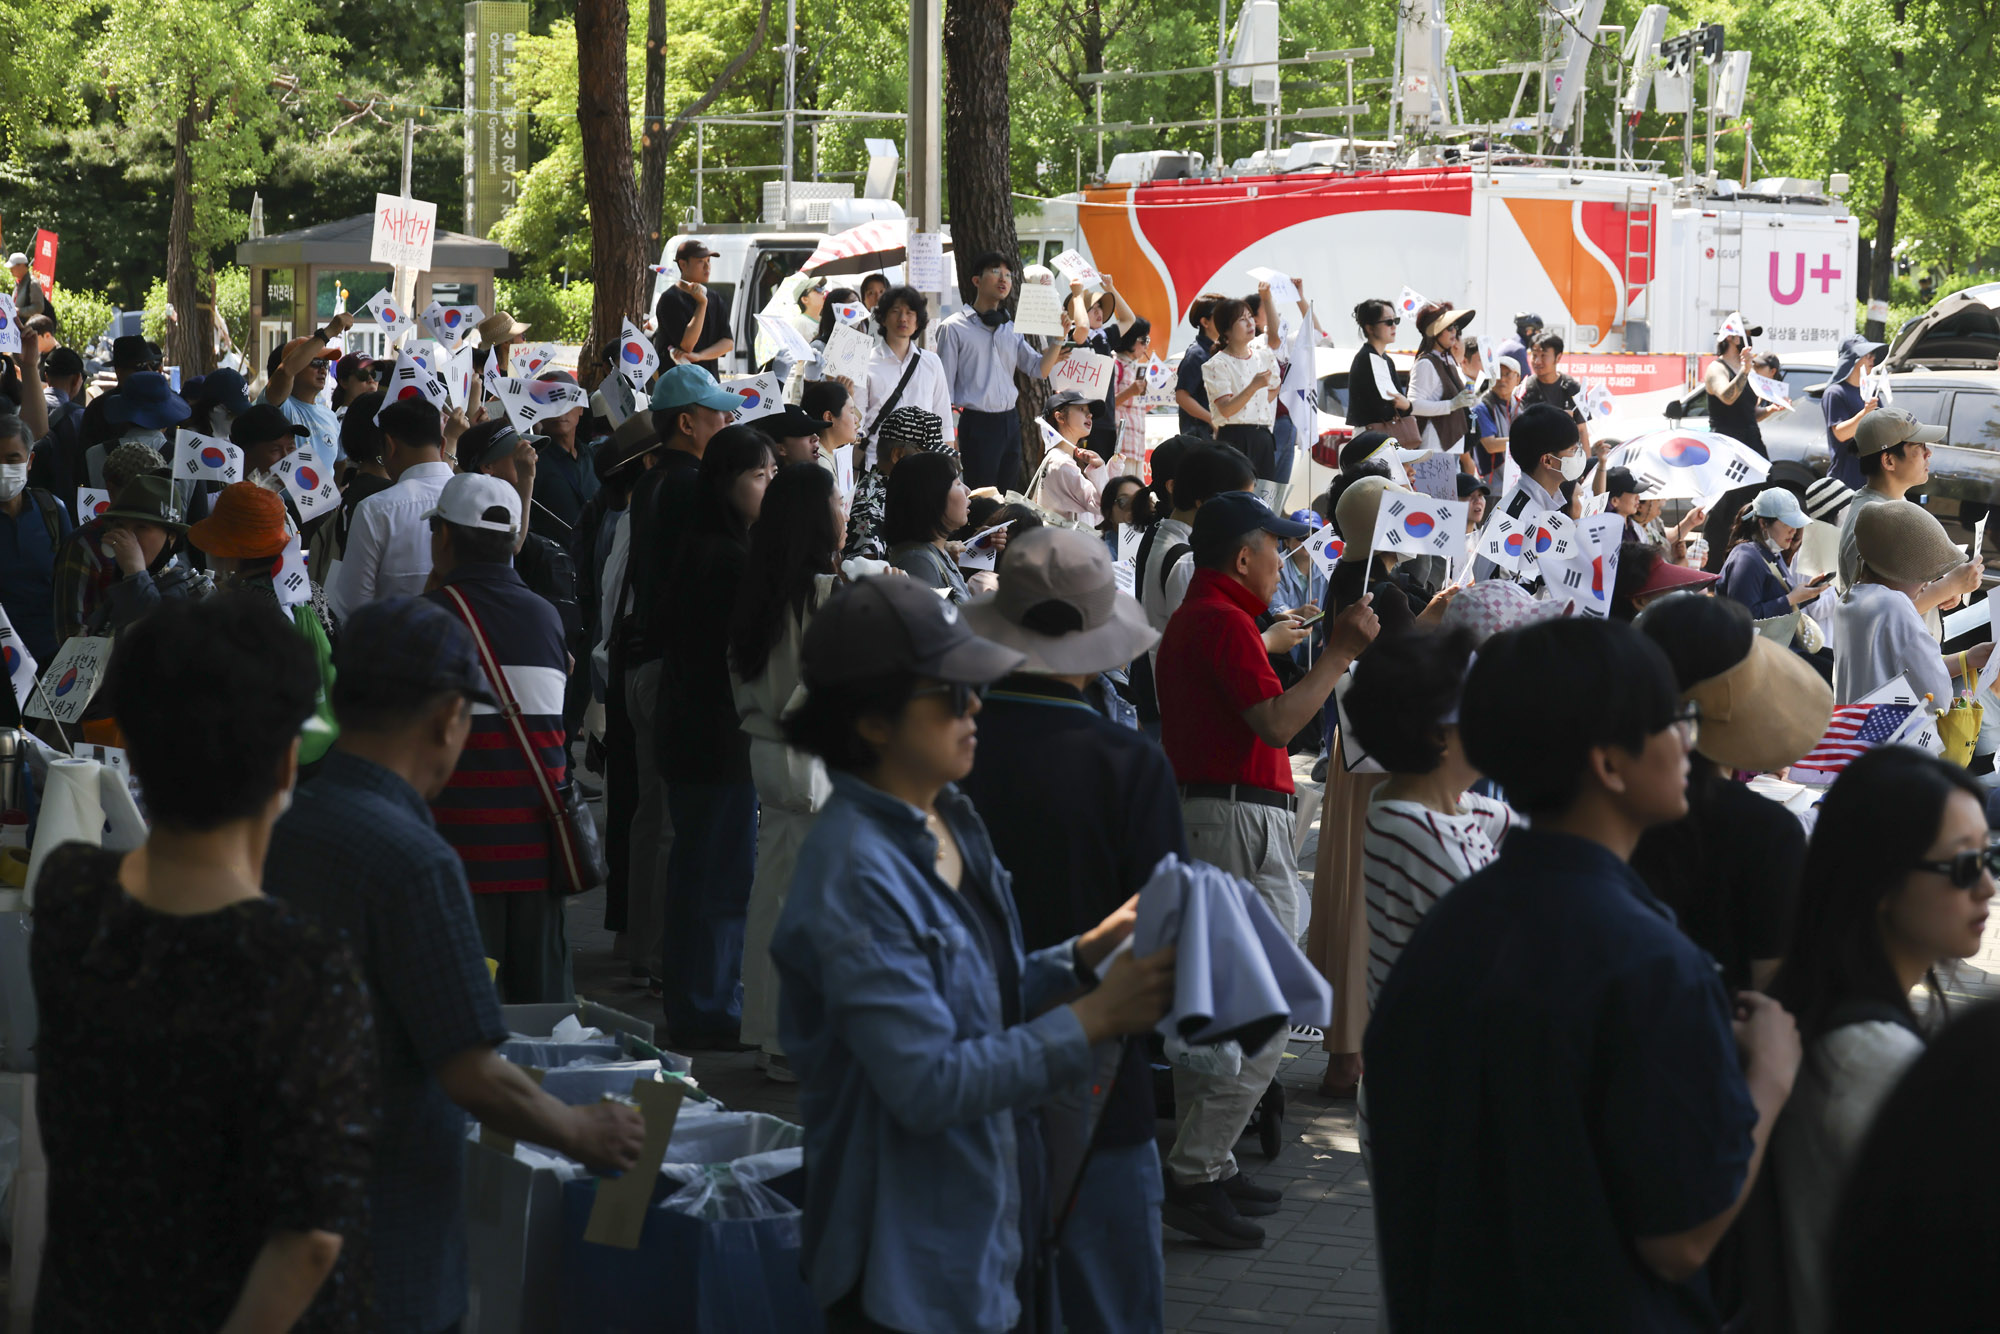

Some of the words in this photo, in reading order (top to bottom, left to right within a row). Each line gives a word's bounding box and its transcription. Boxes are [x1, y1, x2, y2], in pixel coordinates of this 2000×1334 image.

[488, 117, 499, 175] Gymnasium
[380, 207, 431, 247] 재선거
[1768, 250, 1842, 306] U+
[1767, 326, 1797, 341] 일상을
[1800, 327, 1840, 342] 심플하게
[1056, 359, 1103, 388] 재선거
[1588, 363, 1613, 374] 서비스
